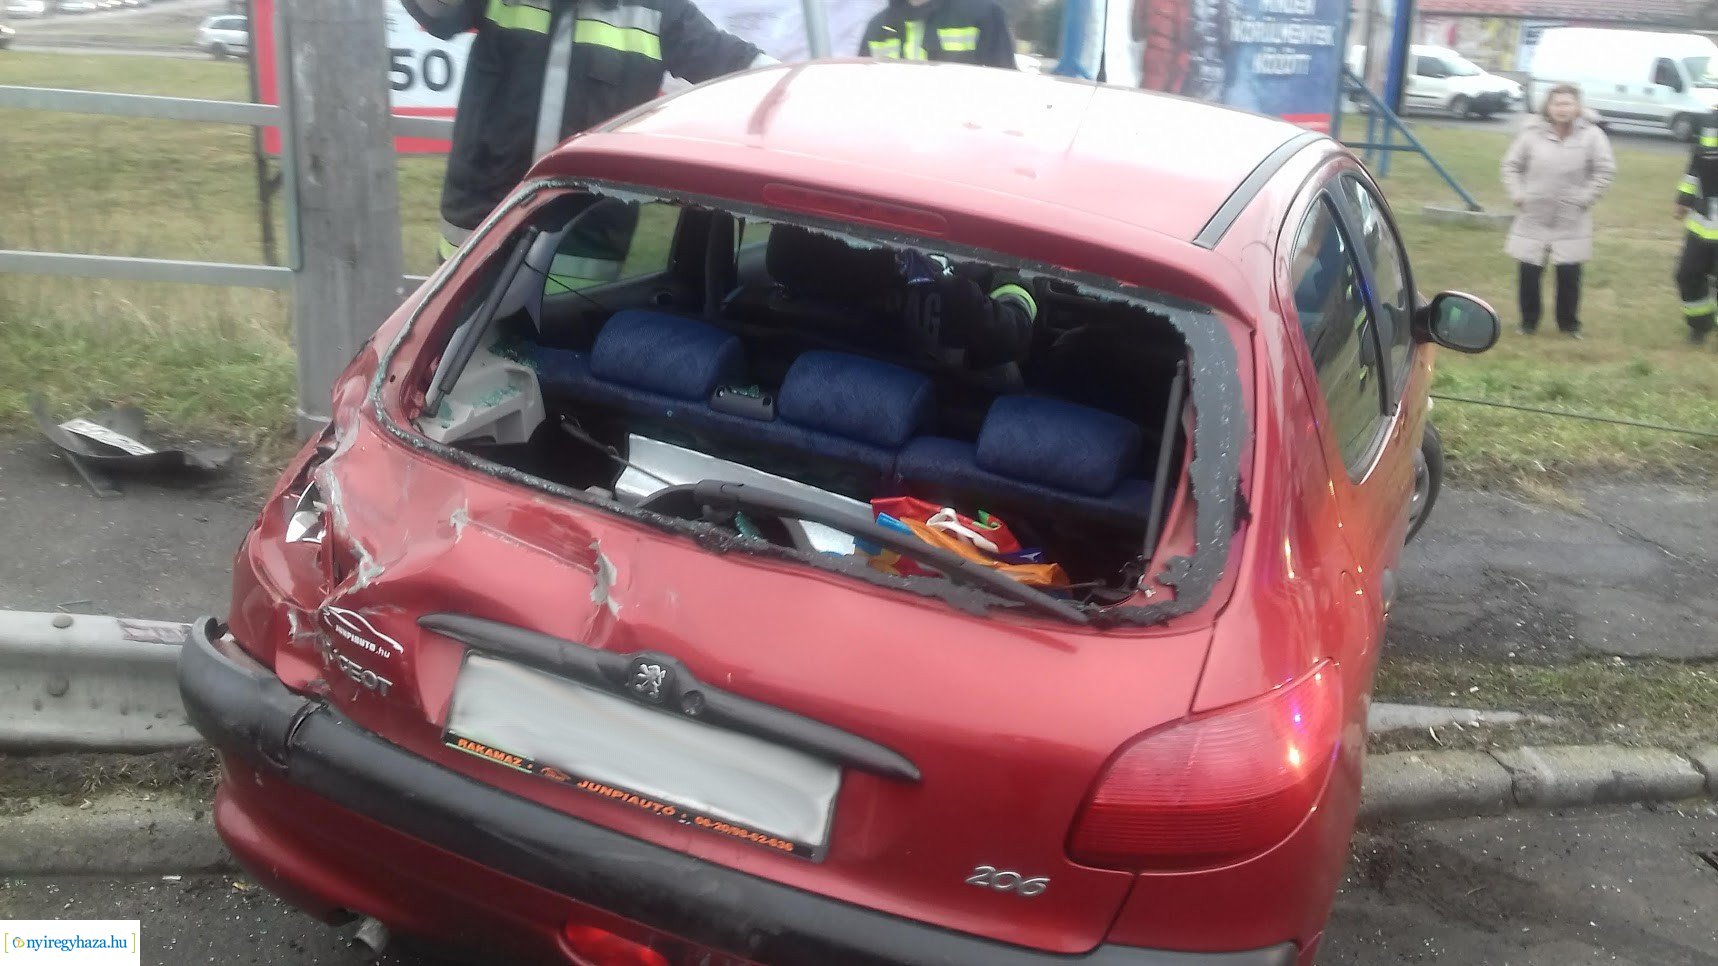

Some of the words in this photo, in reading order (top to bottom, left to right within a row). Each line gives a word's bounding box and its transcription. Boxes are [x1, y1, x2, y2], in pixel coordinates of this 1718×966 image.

[387, 48, 453, 92] 50
[457, 738, 523, 768] RAKAMAZ
[964, 865, 1052, 897] 206
